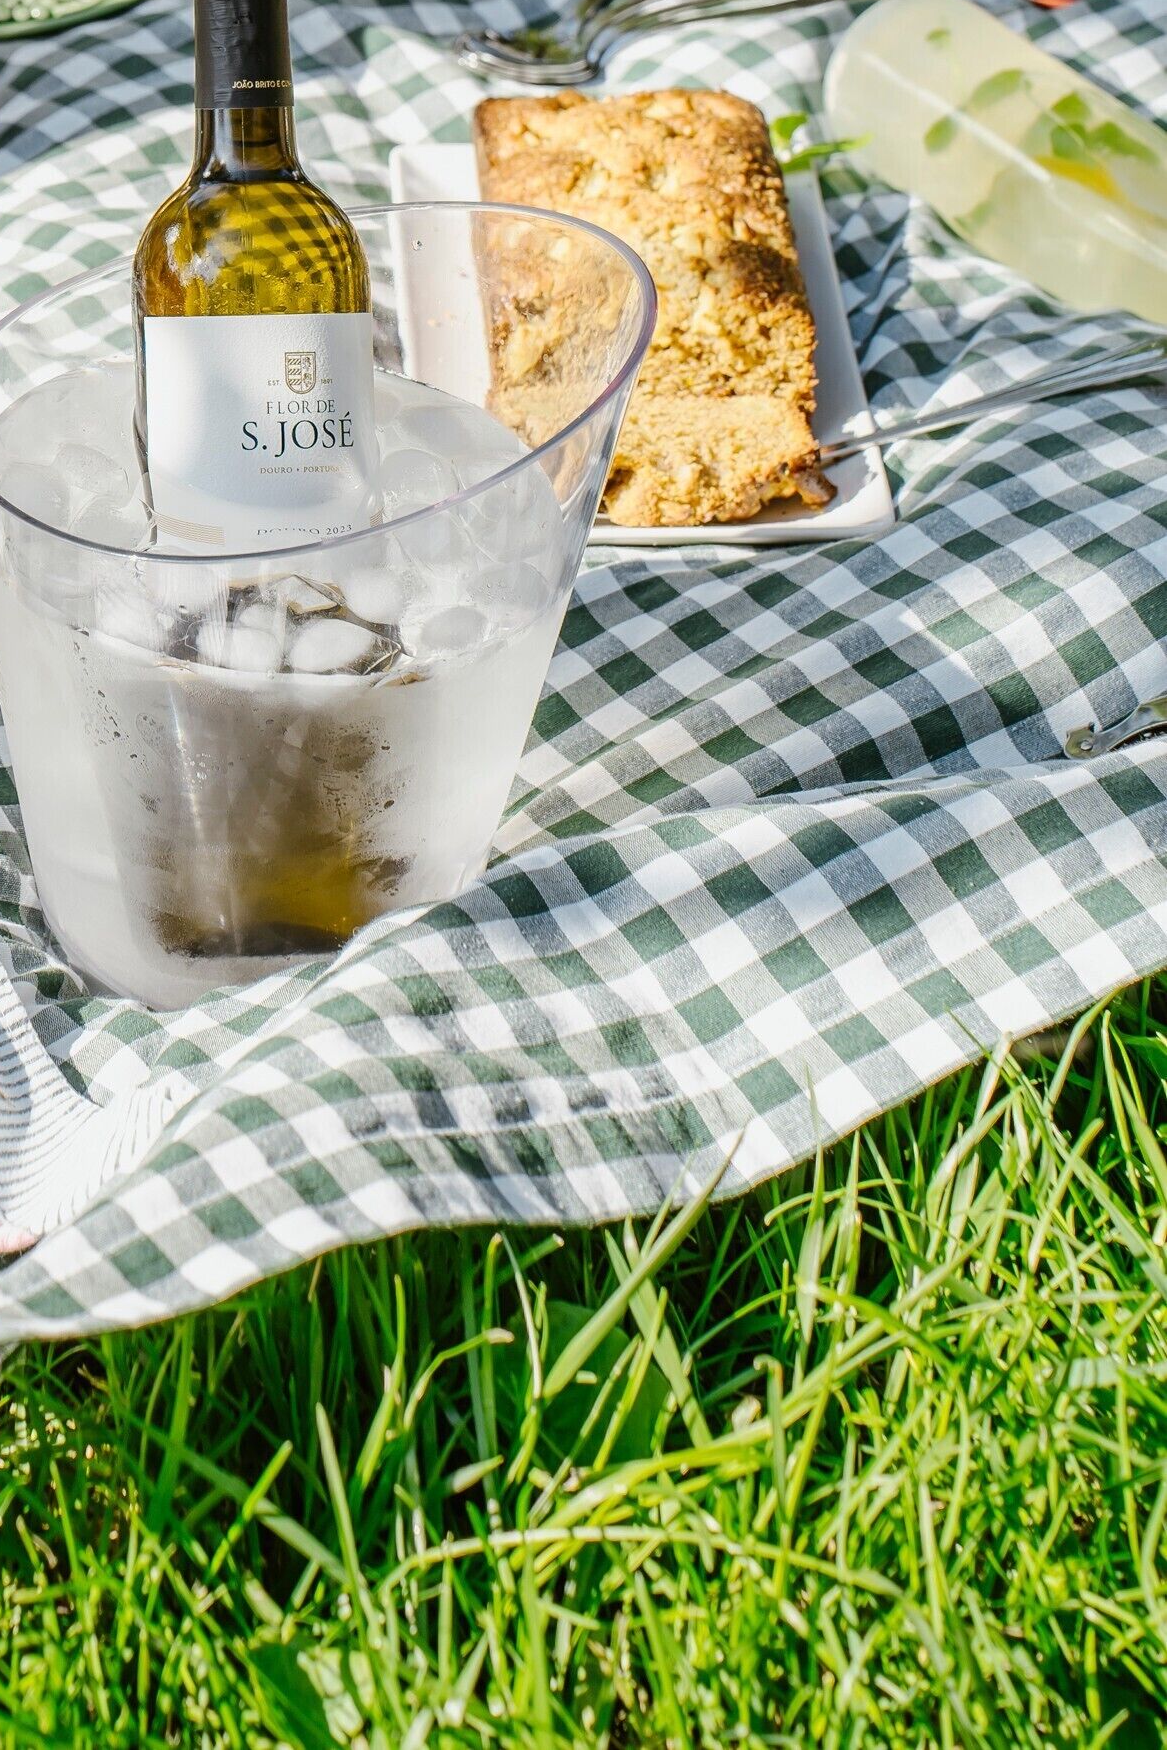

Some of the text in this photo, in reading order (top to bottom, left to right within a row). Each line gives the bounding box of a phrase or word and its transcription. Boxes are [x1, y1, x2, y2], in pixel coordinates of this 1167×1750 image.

[232, 79, 254, 89] JOÃO
[255, 80, 275, 88] BRITO
[266, 399, 336, 415] FLOR DE
[241, 411, 355, 458] S. JOSÉ
[260, 466, 293, 475] DOURO
[326, 524, 352, 536] 2023
